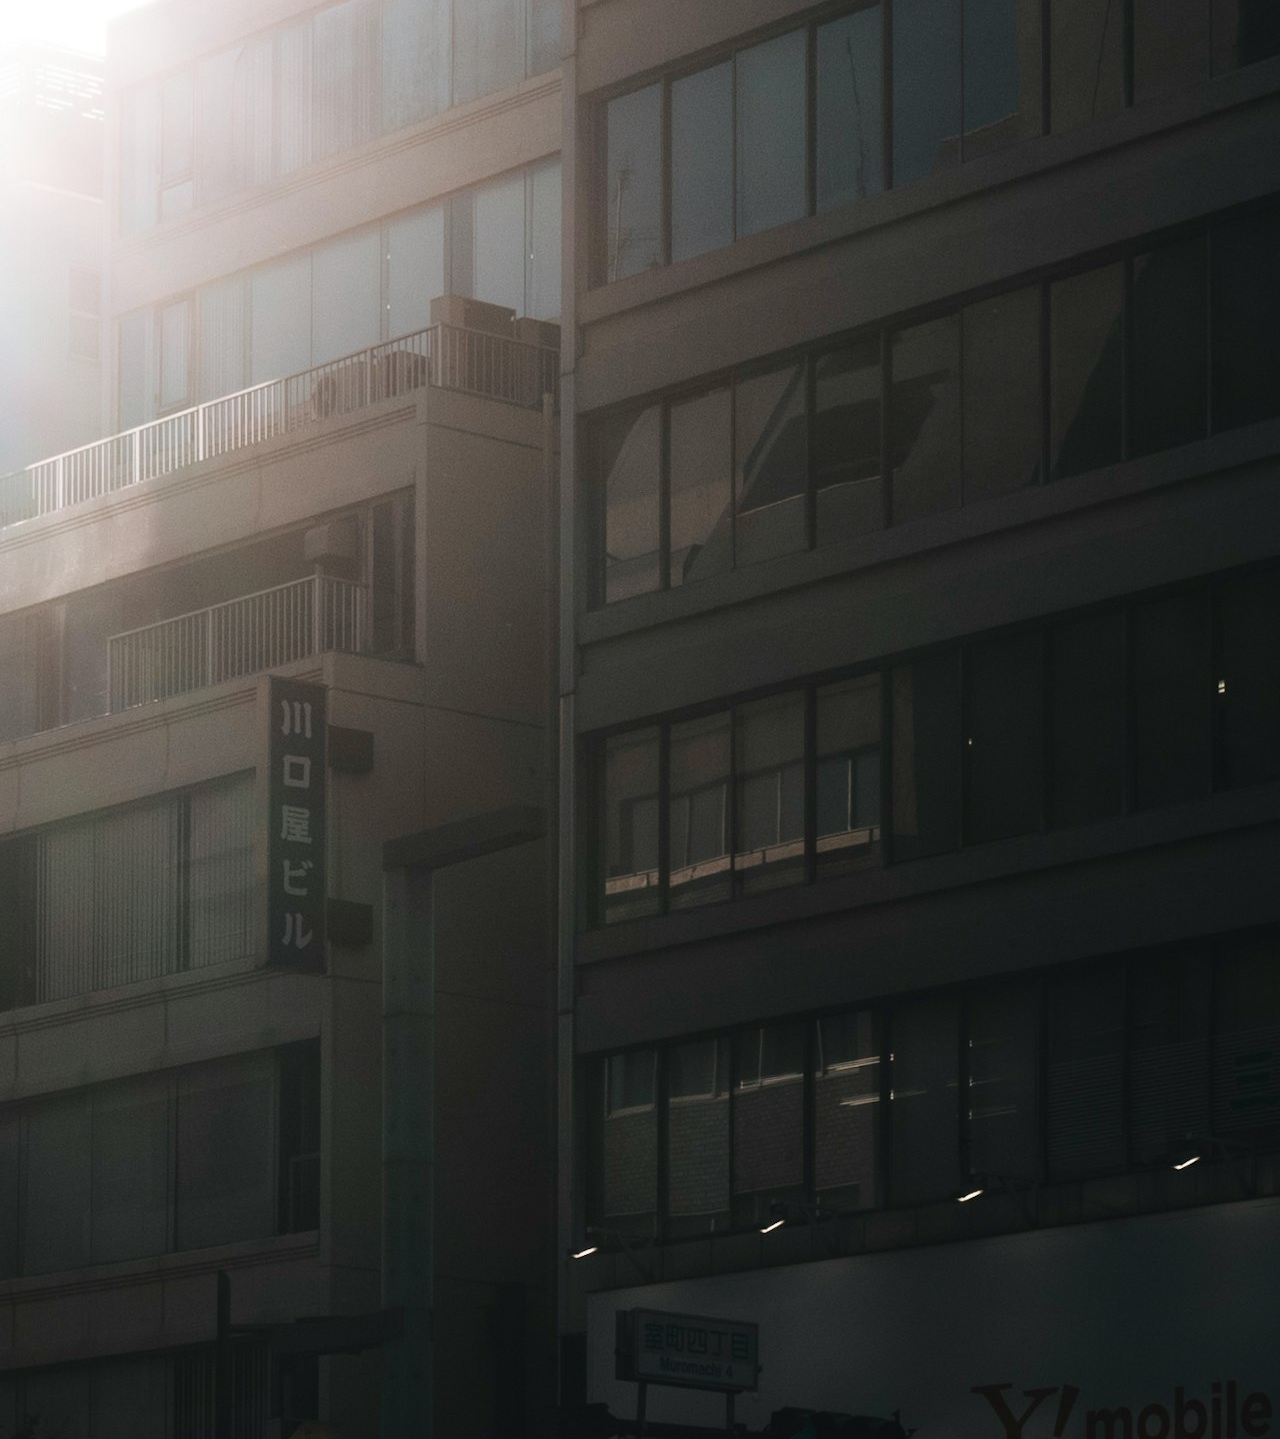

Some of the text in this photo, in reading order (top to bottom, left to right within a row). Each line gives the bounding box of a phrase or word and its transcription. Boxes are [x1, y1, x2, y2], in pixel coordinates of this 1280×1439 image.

[280, 699, 314, 950] 川口屋ビル
[644, 1322, 750, 1361] 室町四丁目
[659, 1354, 734, 1379] Muromachi 4
